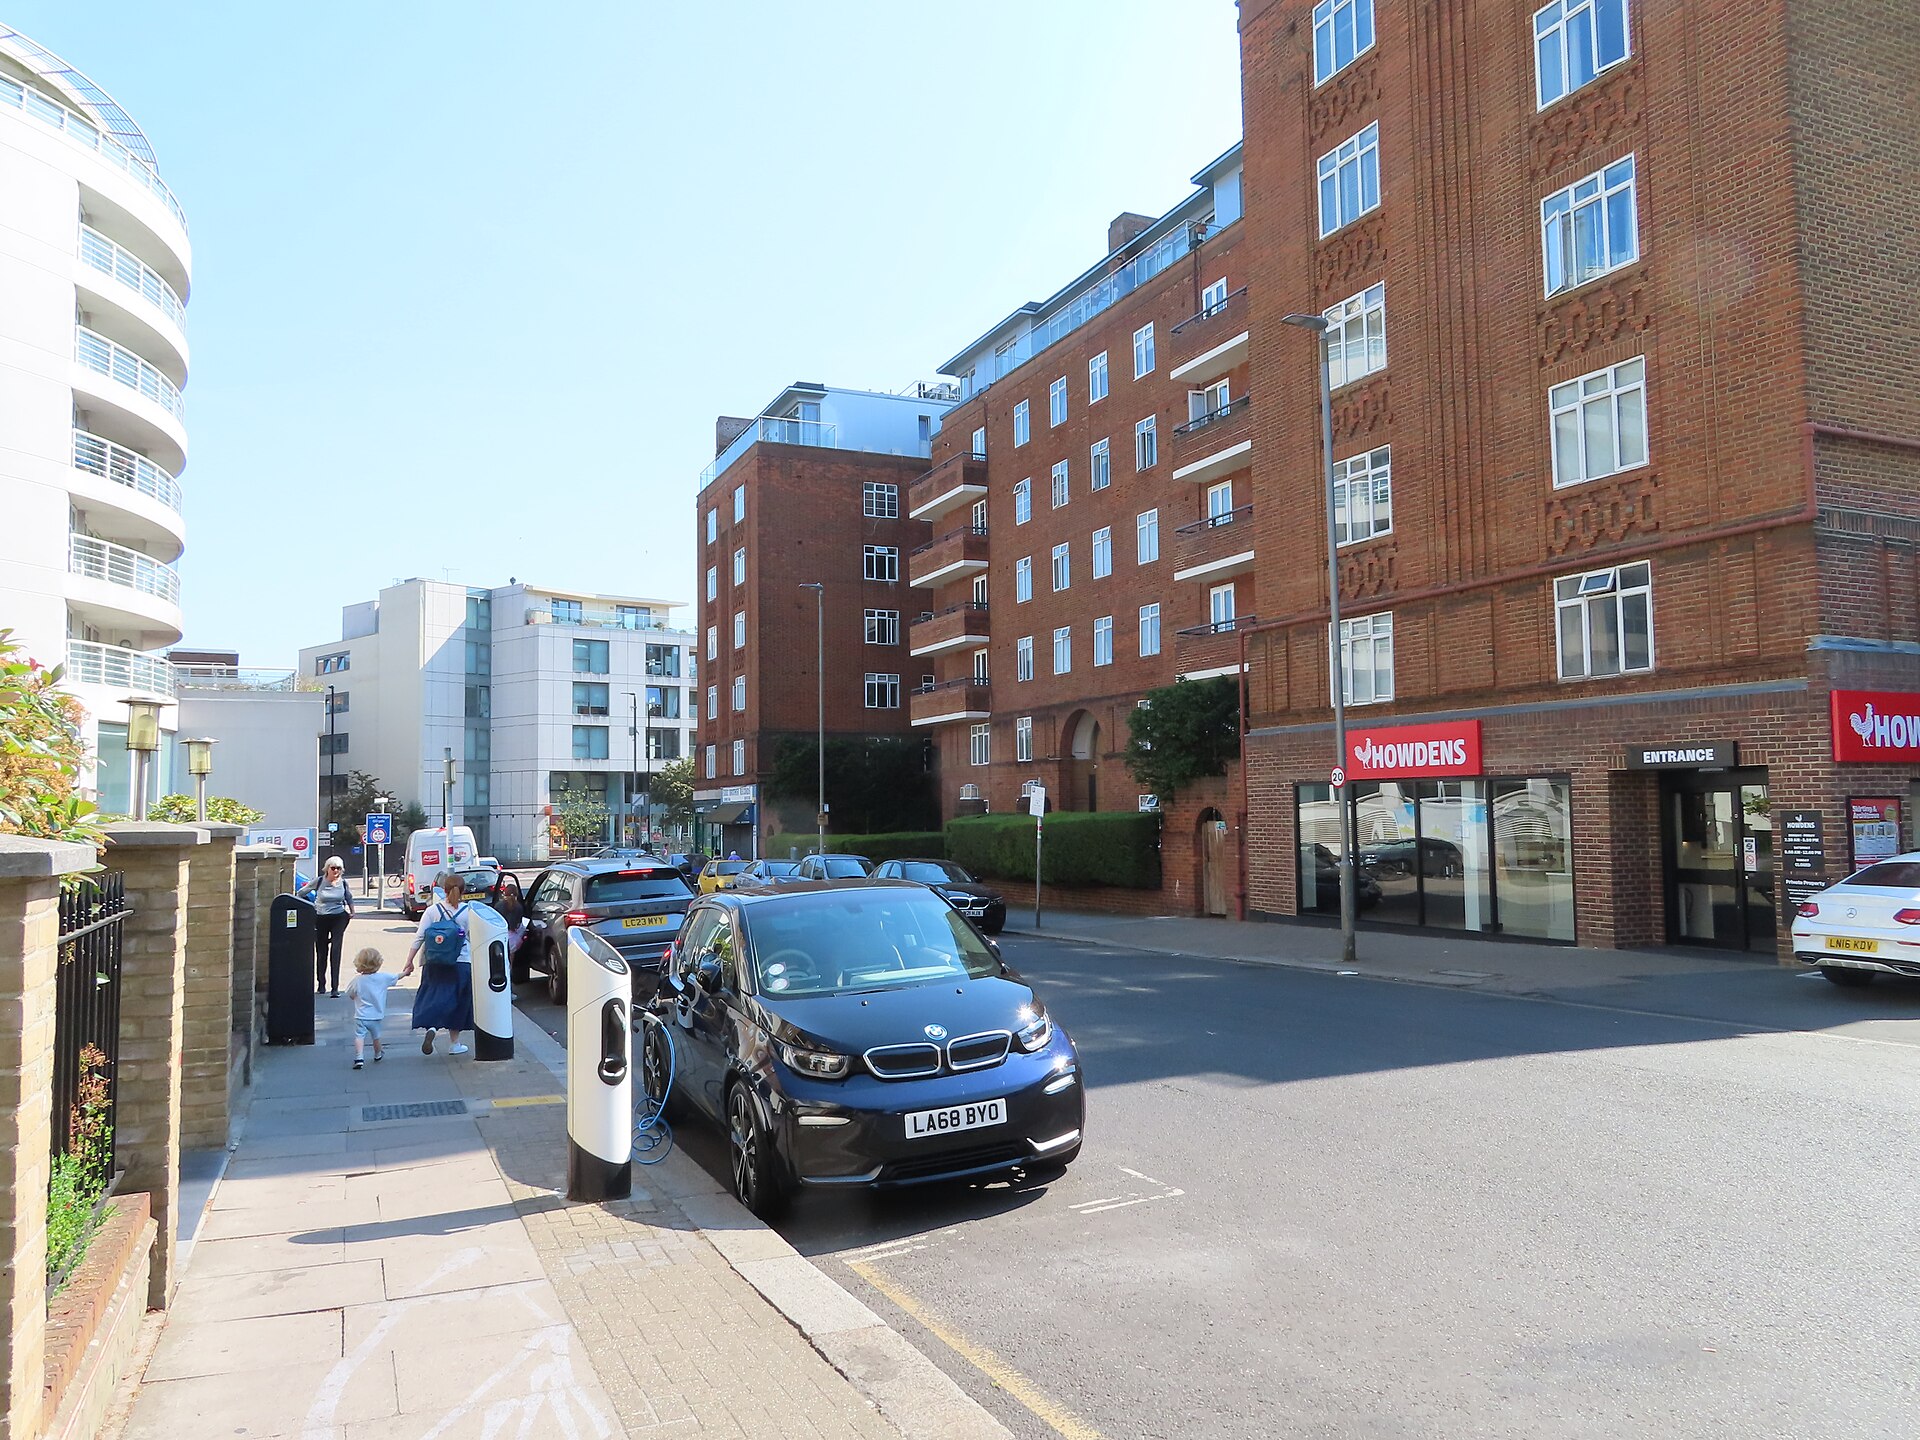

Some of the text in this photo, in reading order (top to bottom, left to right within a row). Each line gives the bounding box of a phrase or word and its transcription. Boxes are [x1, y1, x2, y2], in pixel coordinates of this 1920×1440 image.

[1372, 739, 1467, 769] HOWDENS
[1643, 748, 1714, 764] ENTRANCE
[1332, 772, 1344, 782] 20
[295, 839, 306, 847] £2
[625, 918, 647, 928] LC23
[1829, 938, 1851, 949] LN16
[913, 1103, 999, 1134] LA68 BYO
